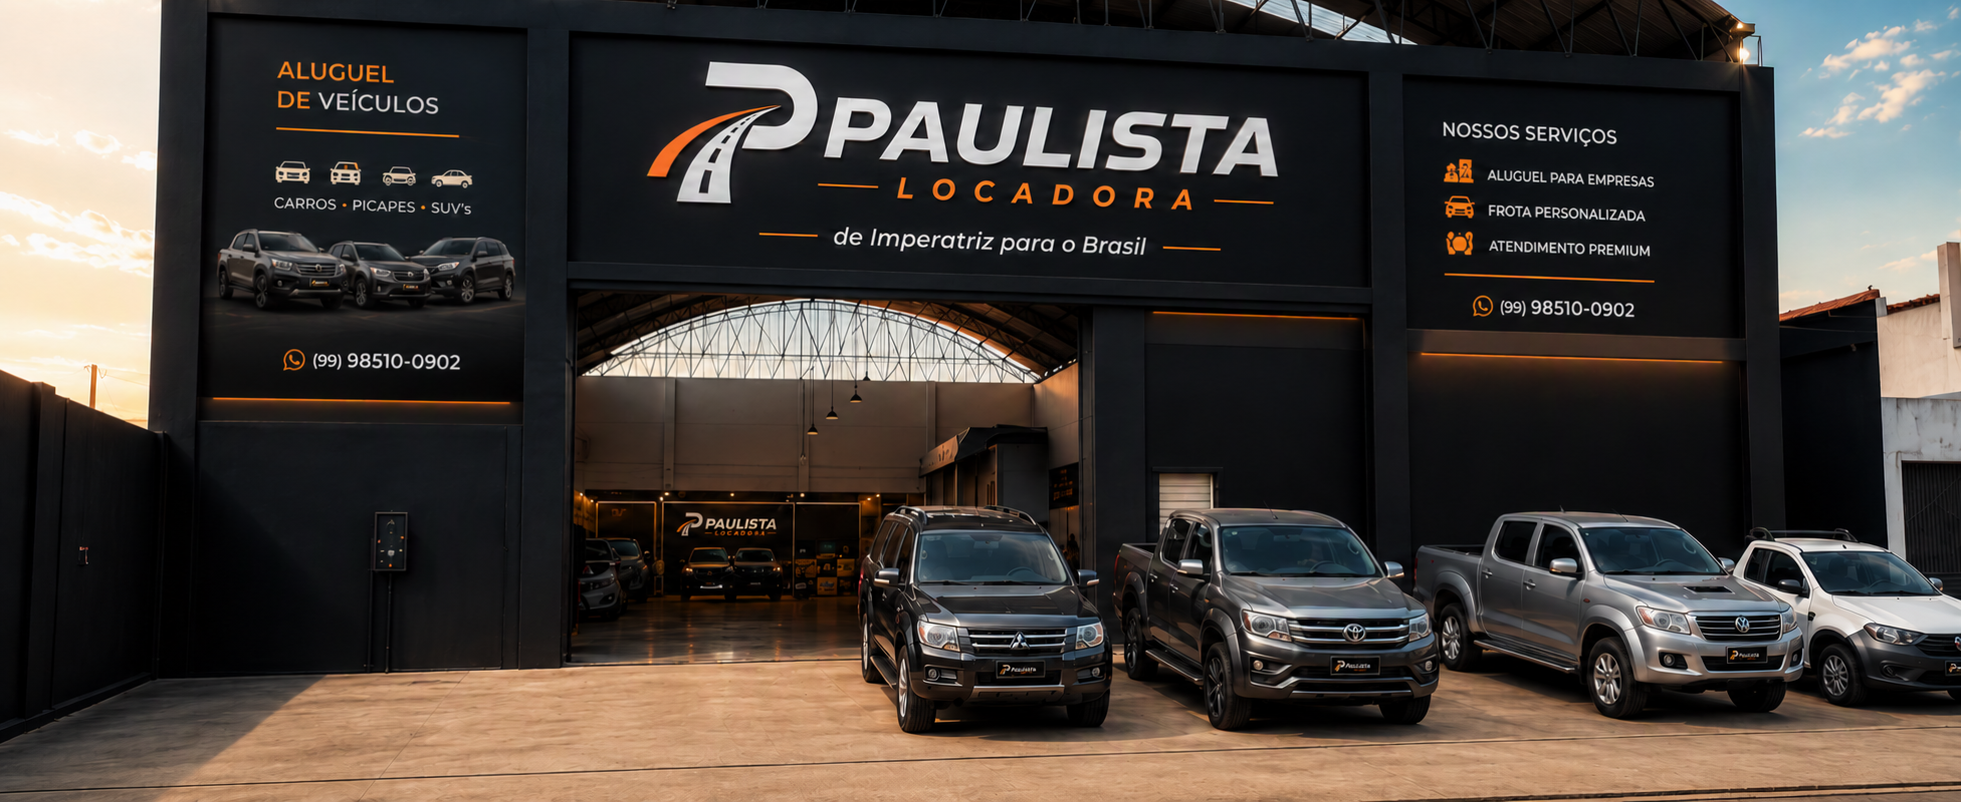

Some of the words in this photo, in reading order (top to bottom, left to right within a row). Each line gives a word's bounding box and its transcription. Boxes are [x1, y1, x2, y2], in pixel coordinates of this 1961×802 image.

[277, 61, 395, 84] ALUGUEL
[277, 91, 311, 110] DE
[318, 89, 439, 115] VEÍCULOS
[824, 97, 1279, 177] PAULISTA
[1443, 121, 1520, 140] NOSSOS
[1525, 126, 1618, 147] SERVIÇOS
[1487, 169, 1547, 183] ALUGUEL
[1550, 172, 1585, 185] PARA
[1588, 173, 1655, 188] EMPRESAS
[897, 177, 1193, 211] LOCADORA
[274, 196, 337, 211] CARROS
[352, 199, 416, 213] PICAPES
[431, 201, 472, 215] SUV's
[1488, 204, 1532, 218] FROTA
[1535, 206, 1646, 222] PERSONALIZADA
[833, 226, 863, 246] de
[870, 228, 994, 252] Imperatriz
[999, 237, 1055, 256] para
[1061, 239, 1076, 253] o
[1083, 236, 1147, 256] Brasil
[1488, 240, 1586, 255] ATENDIMENTO
[1589, 243, 1651, 257] PREMIUM
[1500, 300, 1527, 317] (99)
[1530, 299, 1635, 318] 98510-0902
[312, 353, 342, 370] (99)
[347, 352, 461, 370] 98510-0902
[705, 518, 777, 530] PAULISTA
